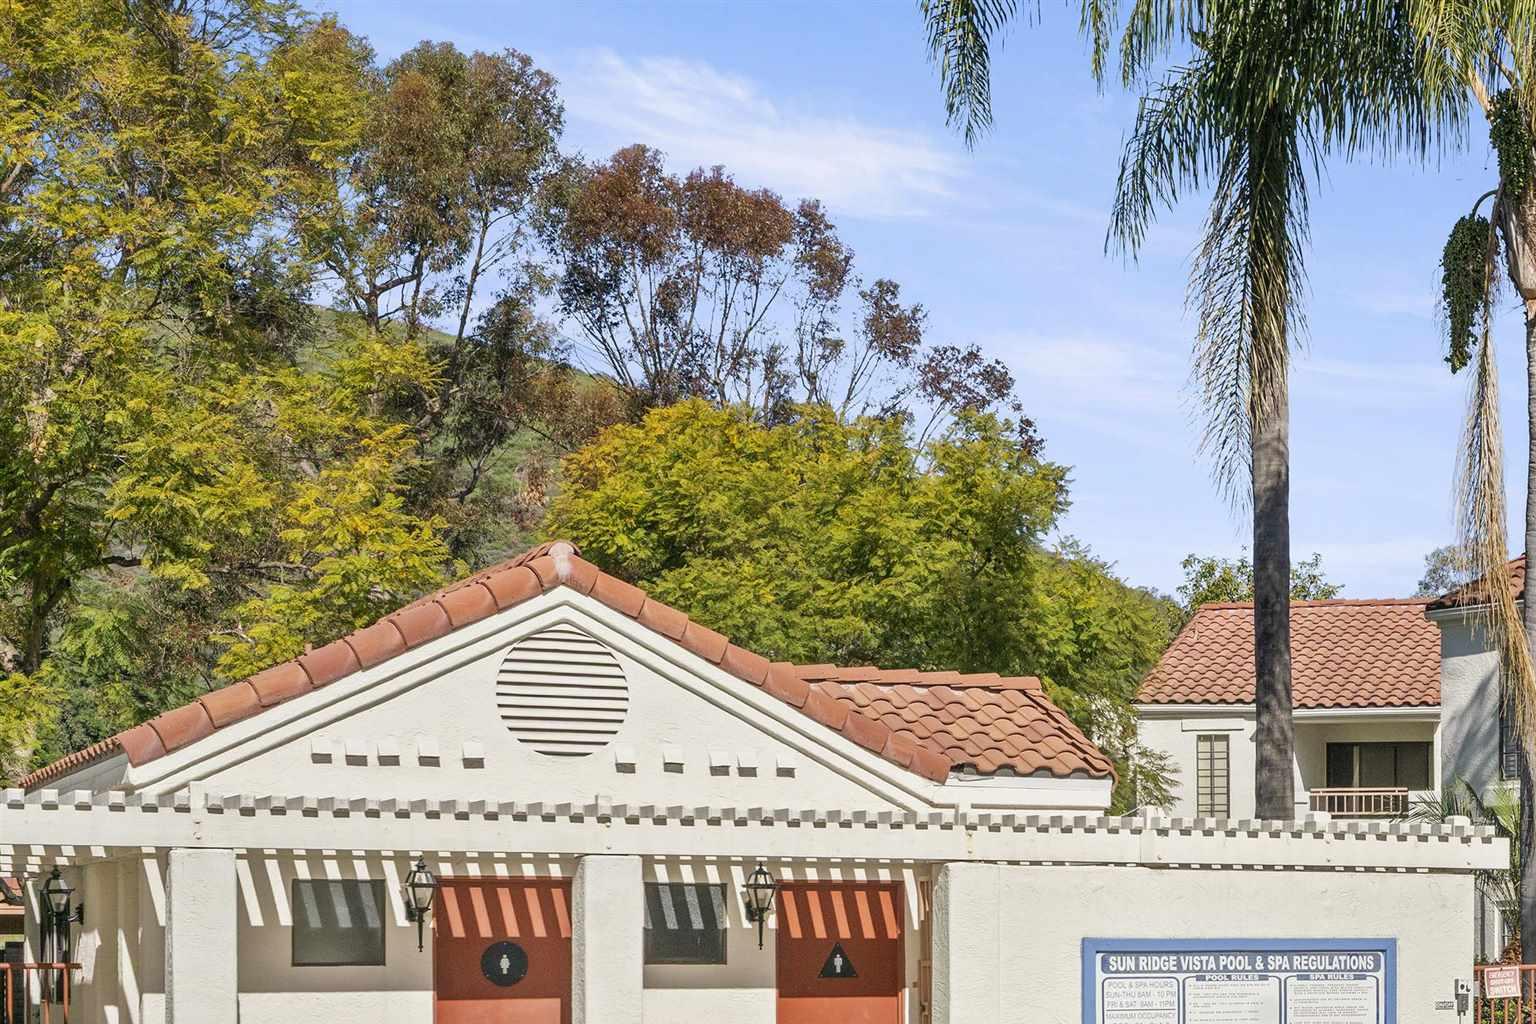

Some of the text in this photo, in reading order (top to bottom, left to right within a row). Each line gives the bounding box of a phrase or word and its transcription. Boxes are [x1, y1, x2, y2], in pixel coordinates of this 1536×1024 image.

[1108, 955, 1375, 971] SUN RIDGE VISTA POOL & SPA REGULATIONS
